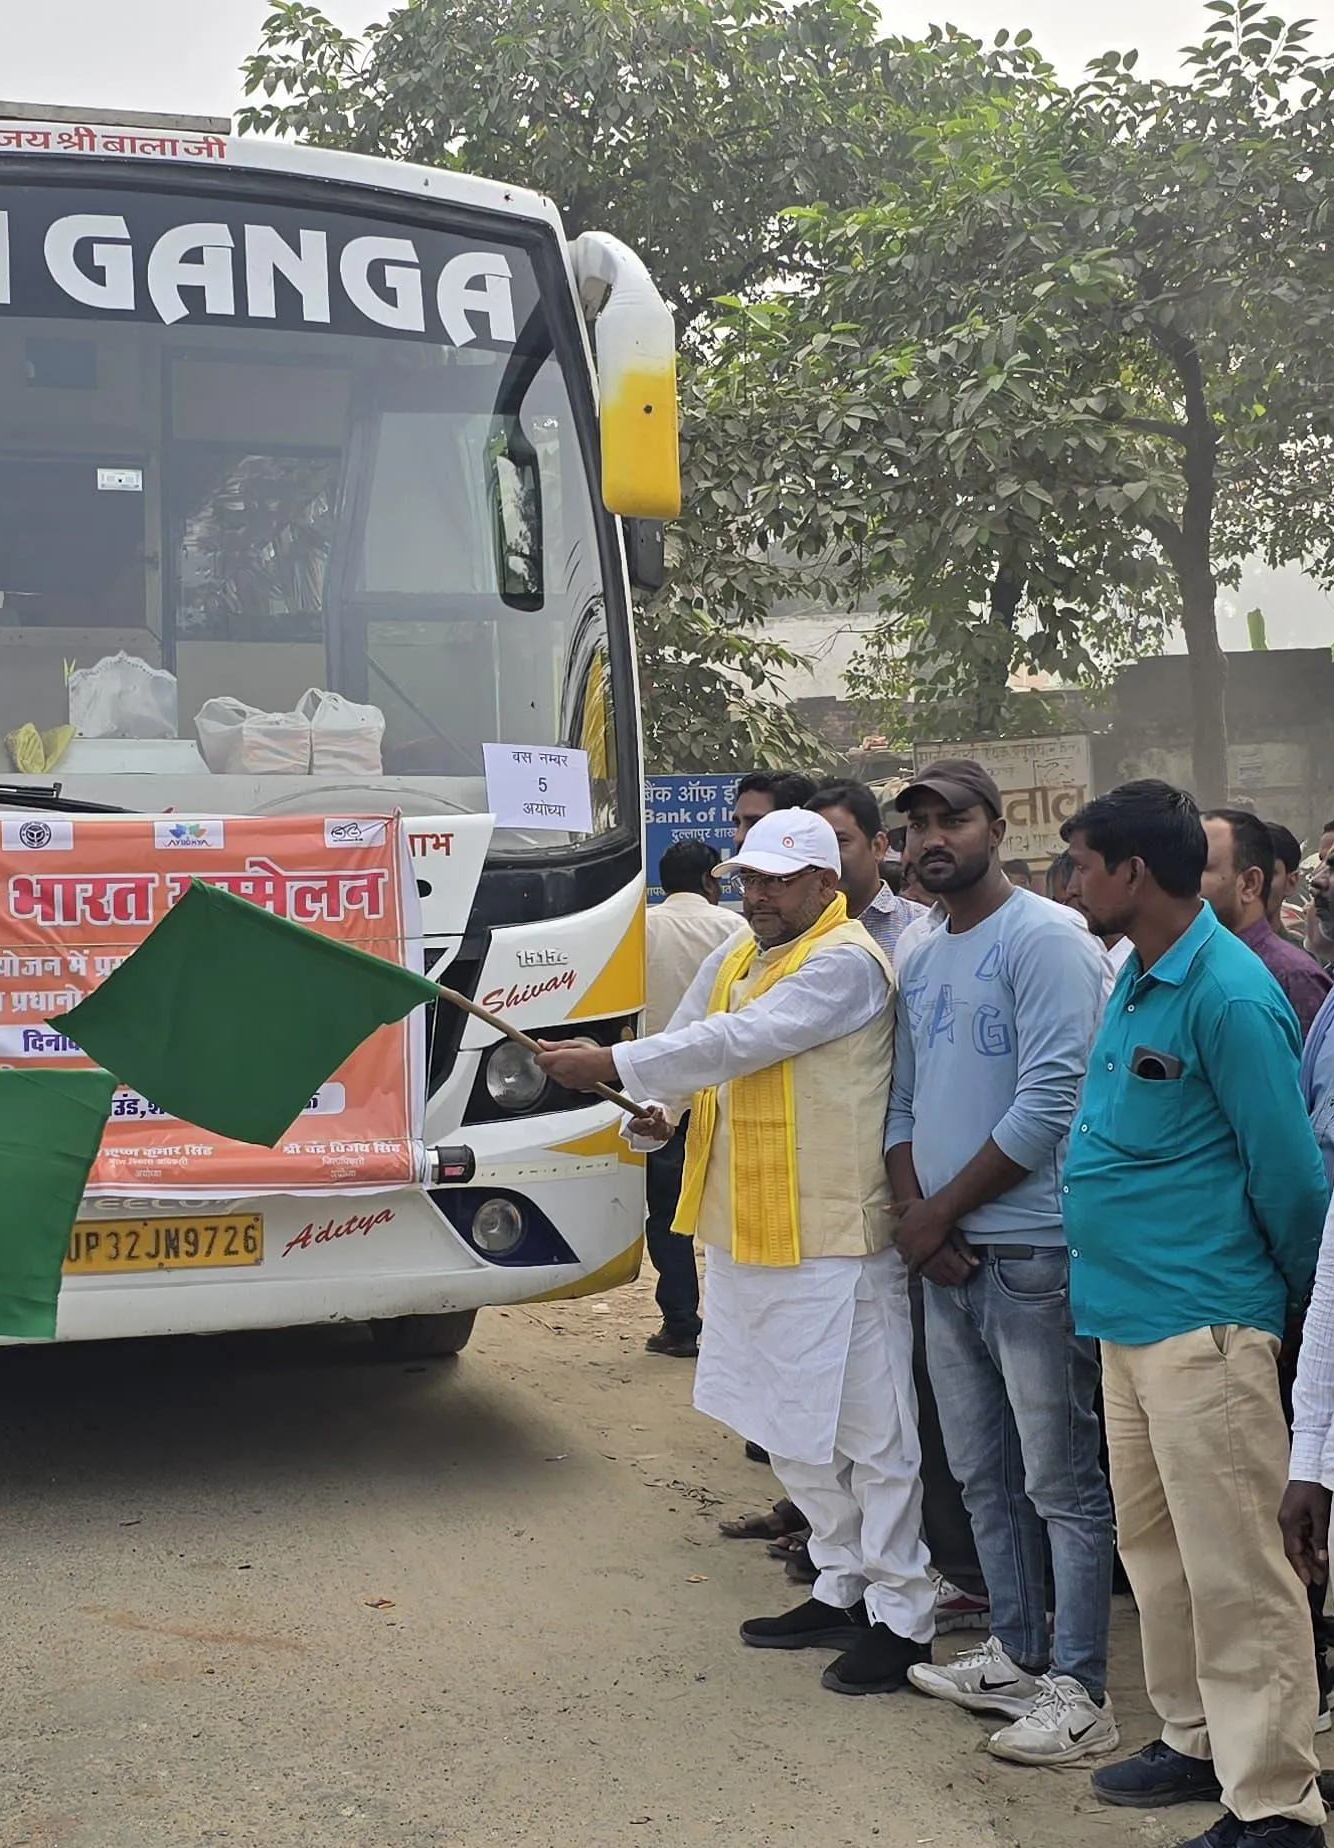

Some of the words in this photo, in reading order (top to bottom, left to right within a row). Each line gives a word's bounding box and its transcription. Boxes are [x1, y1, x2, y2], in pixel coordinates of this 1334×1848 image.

[56, 126, 97, 152] श्री
[43, 214, 517, 349] GANGA
[538, 777, 548, 792] 5
[523, 800, 566, 818] अयोध्या
[644, 808, 692, 824] Bank
[696, 807, 717, 822] of
[409, 833, 455, 857] ाभ
[714, 828, 737, 839] शाख
[9, 873, 158, 927] भारत
[68, 949, 90, 977] में
[481, 968, 578, 1015] Shivay
[282, 1207, 396, 1258] Aditya
